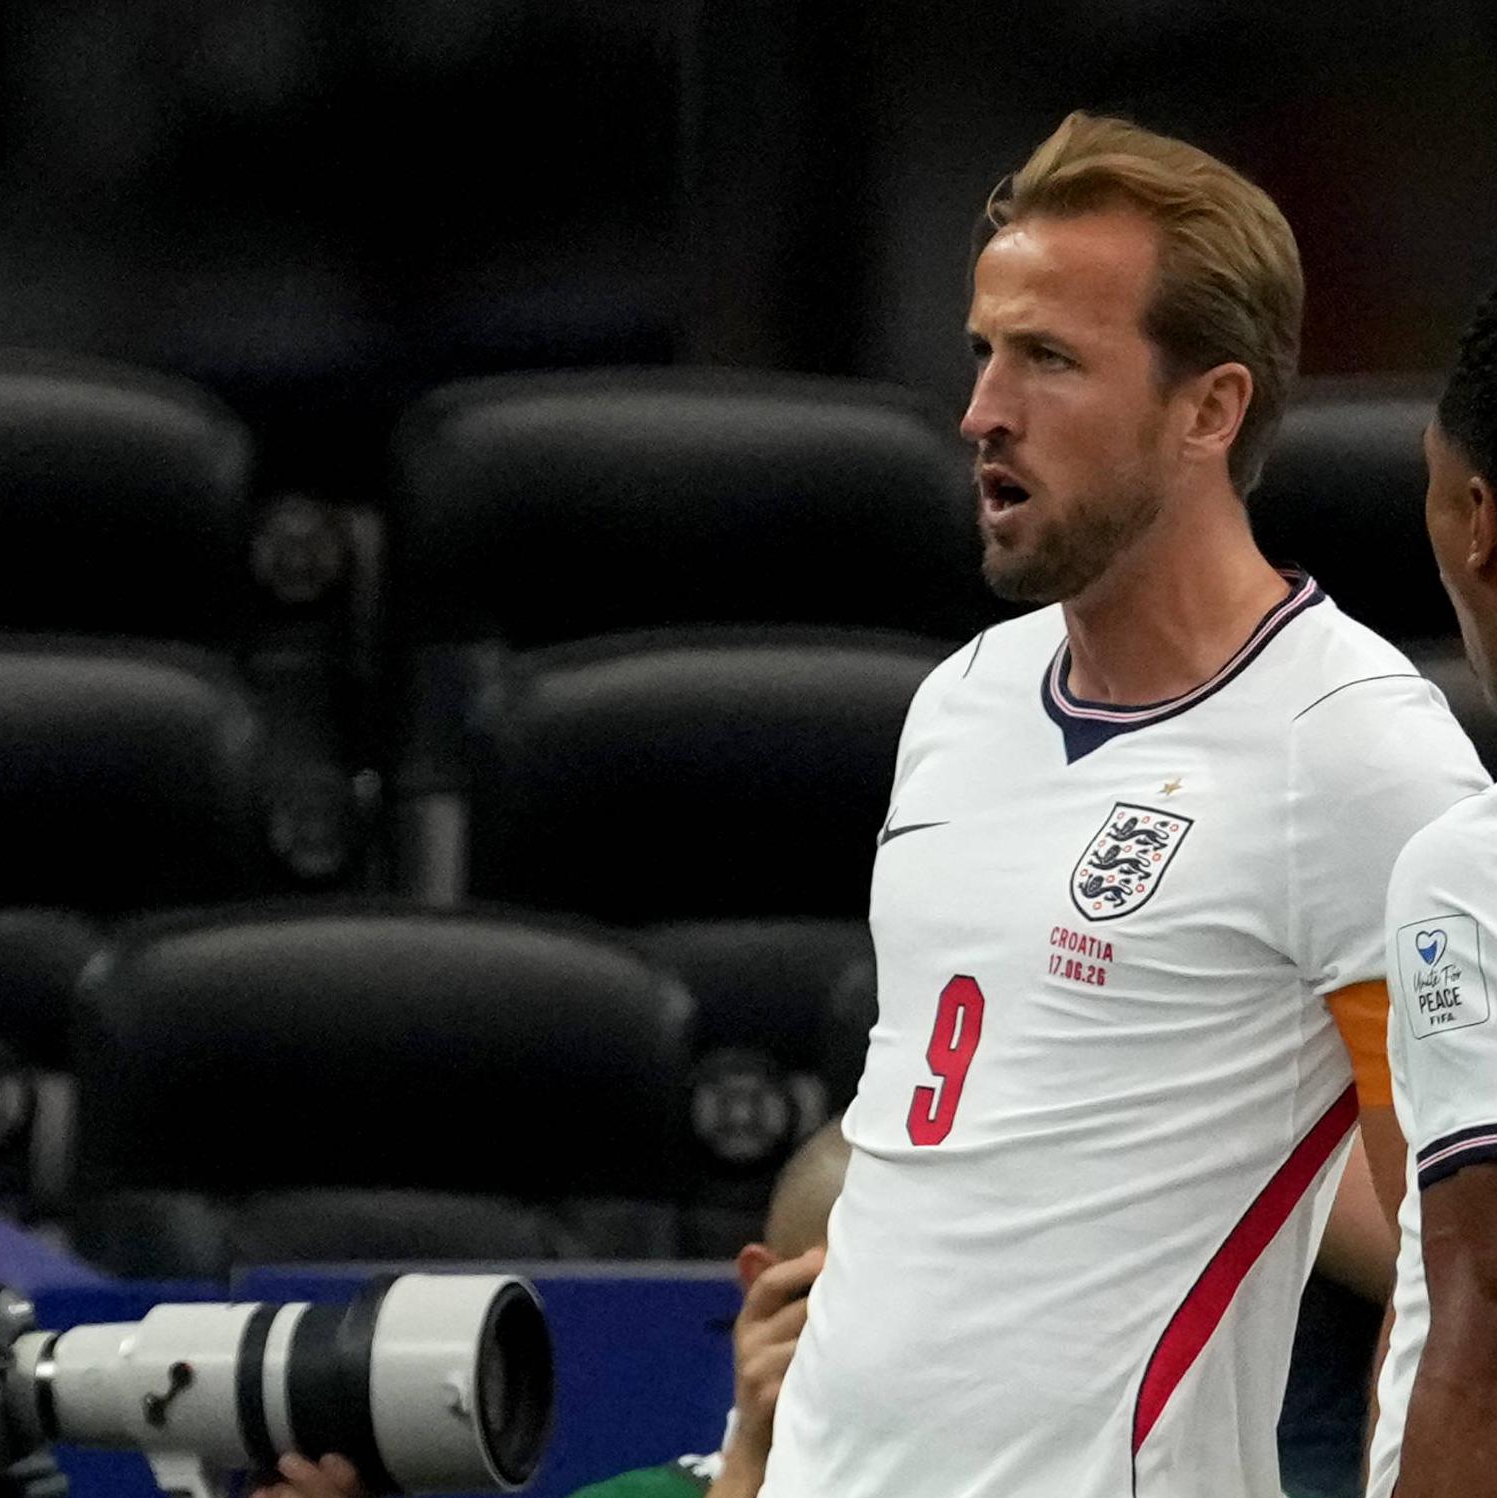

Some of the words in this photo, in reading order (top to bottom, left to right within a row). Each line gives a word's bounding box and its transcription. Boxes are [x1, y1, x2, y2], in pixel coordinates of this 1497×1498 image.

[1049, 926, 1114, 962] CROATIA
[1048, 953, 1107, 986] 17.06.26
[1418, 986, 1462, 1014] PEACE
[1430, 1012, 1457, 1026] FIFA
[906, 974, 985, 1147] 9
